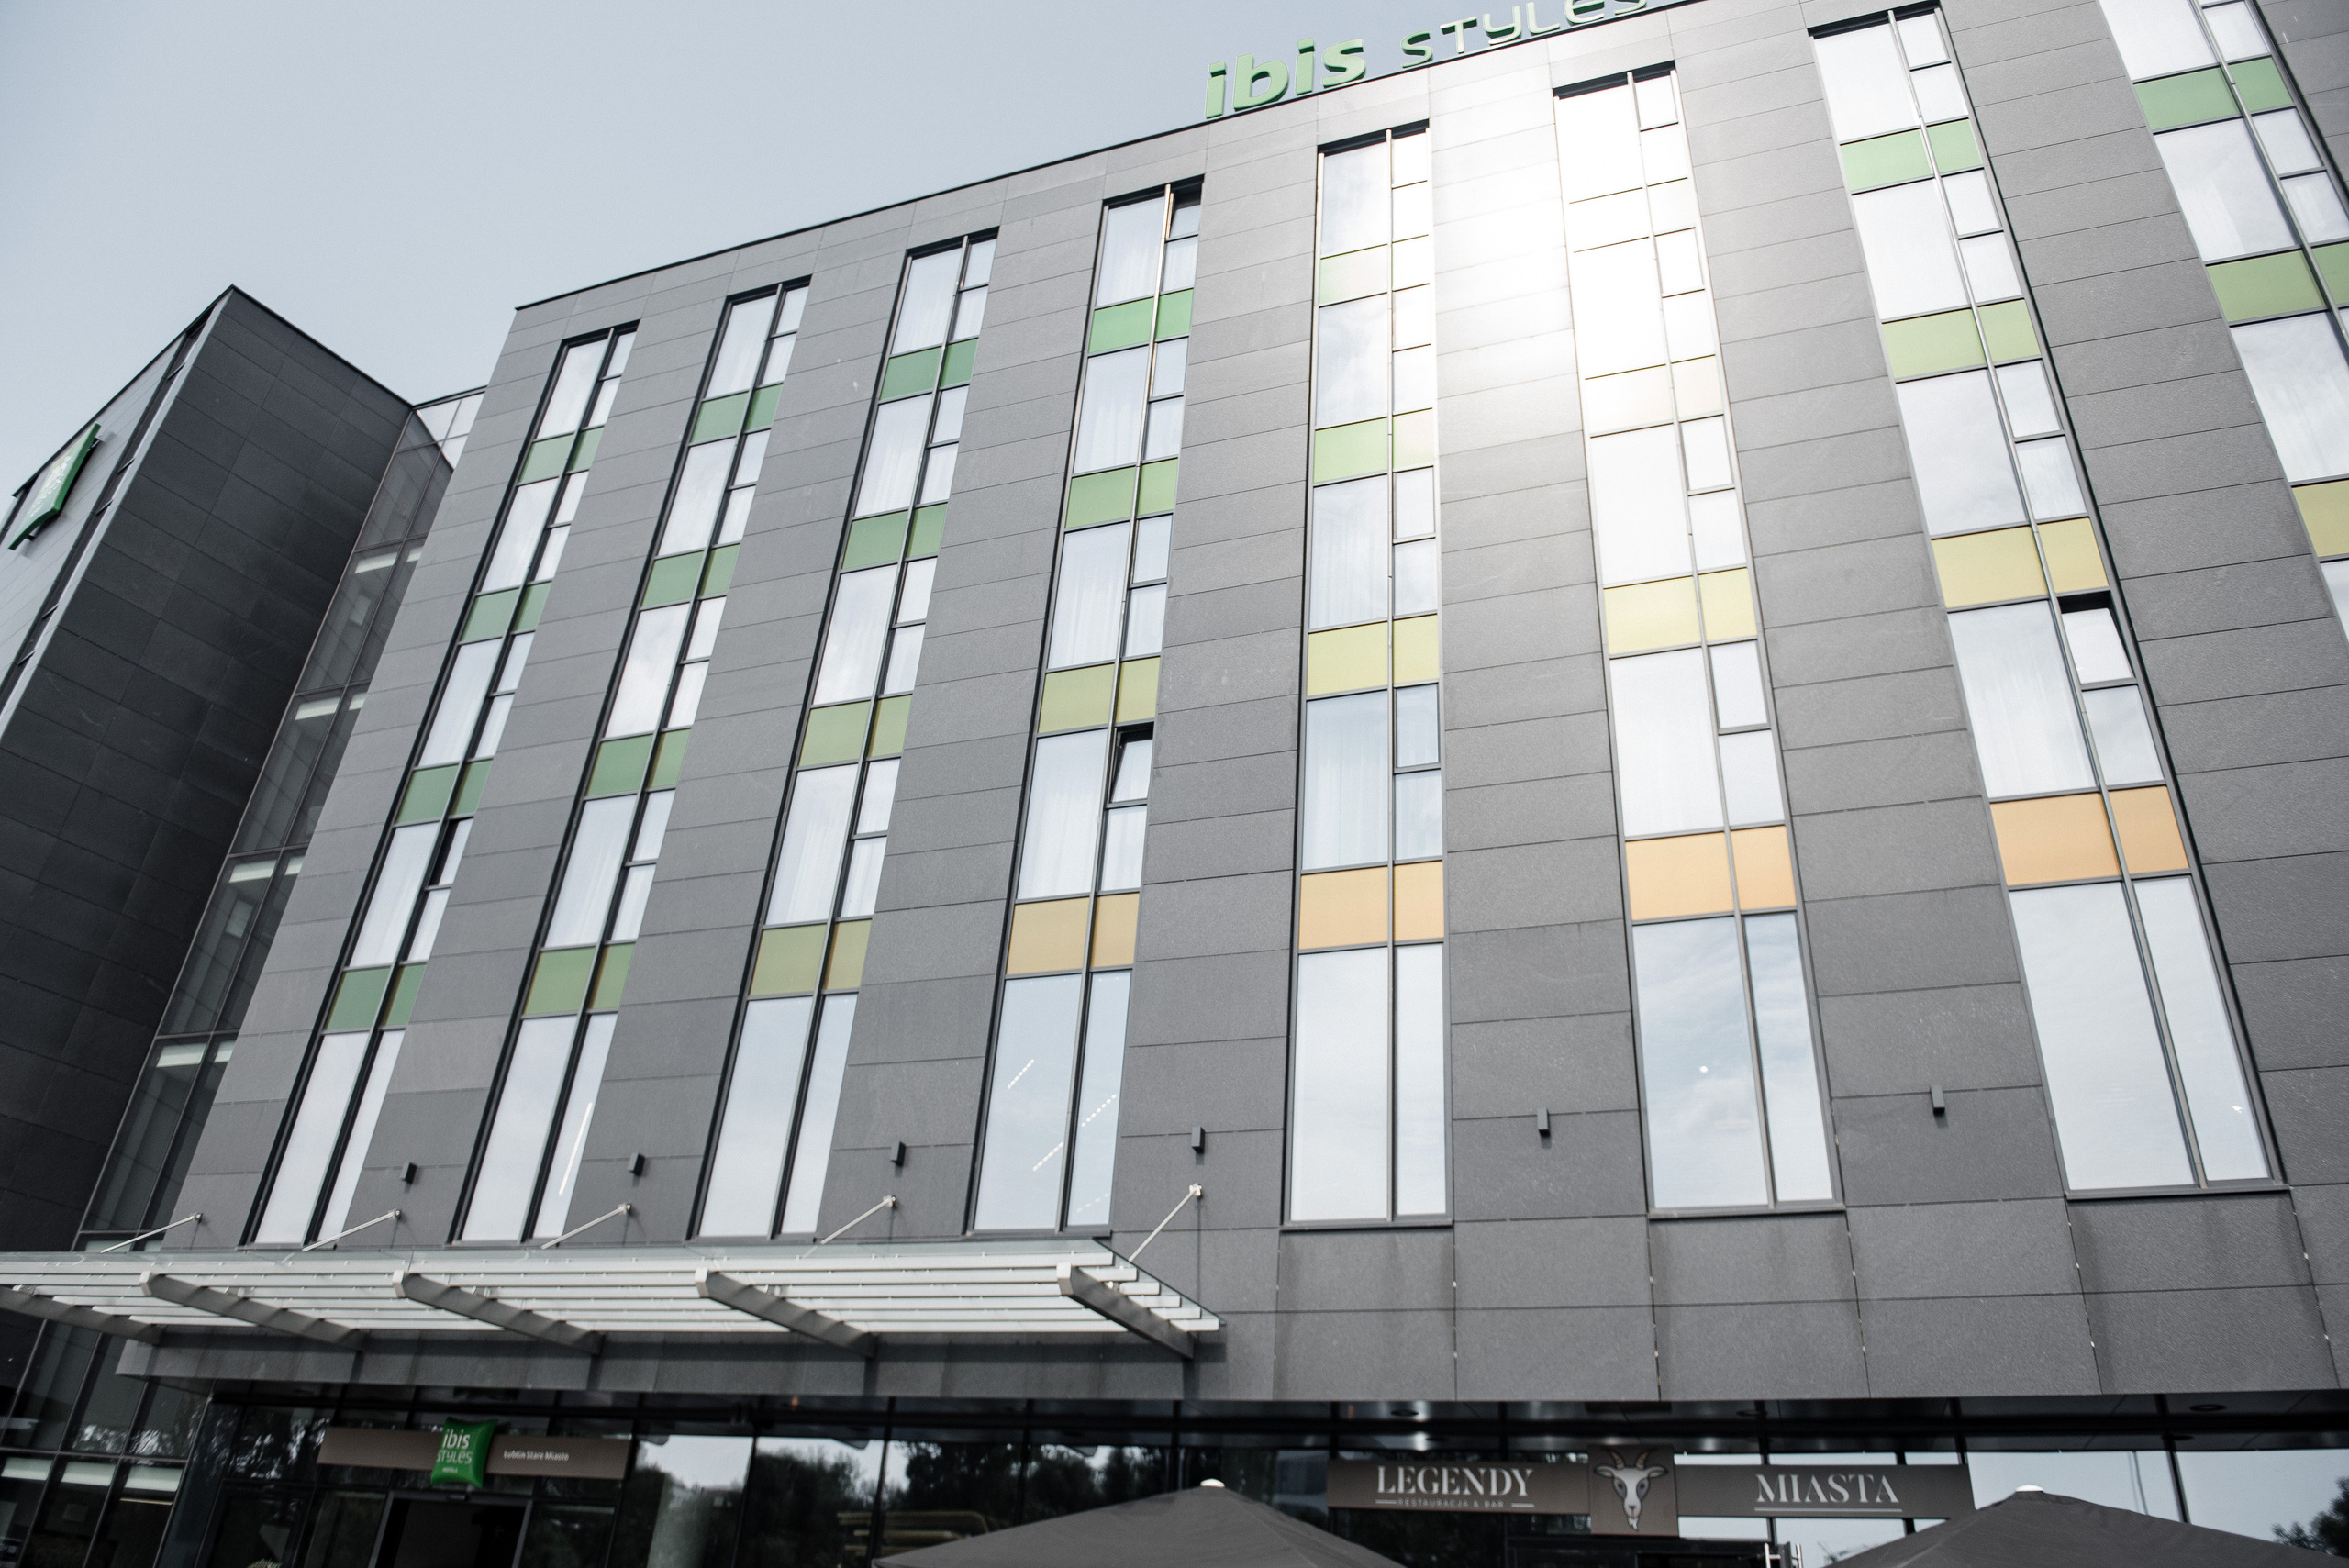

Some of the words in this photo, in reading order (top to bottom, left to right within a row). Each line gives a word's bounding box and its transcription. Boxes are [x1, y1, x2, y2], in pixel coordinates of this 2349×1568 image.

[1205, 38, 1366, 118] ibis
[442, 1429, 471, 1450] ibis
[436, 1449, 473, 1464] STYLES
[504, 1450, 526, 1460] Lublin
[527, 1450, 544, 1461] Stare
[545, 1451, 570, 1462] Miasto
[1376, 1465, 1533, 1496] LEGENDY
[1756, 1473, 1899, 1503] MIASTA
[1397, 1498, 1469, 1508] RESTAURACJA
[1473, 1499, 1480, 1508] &
[1484, 1500, 1505, 1509] BAR
